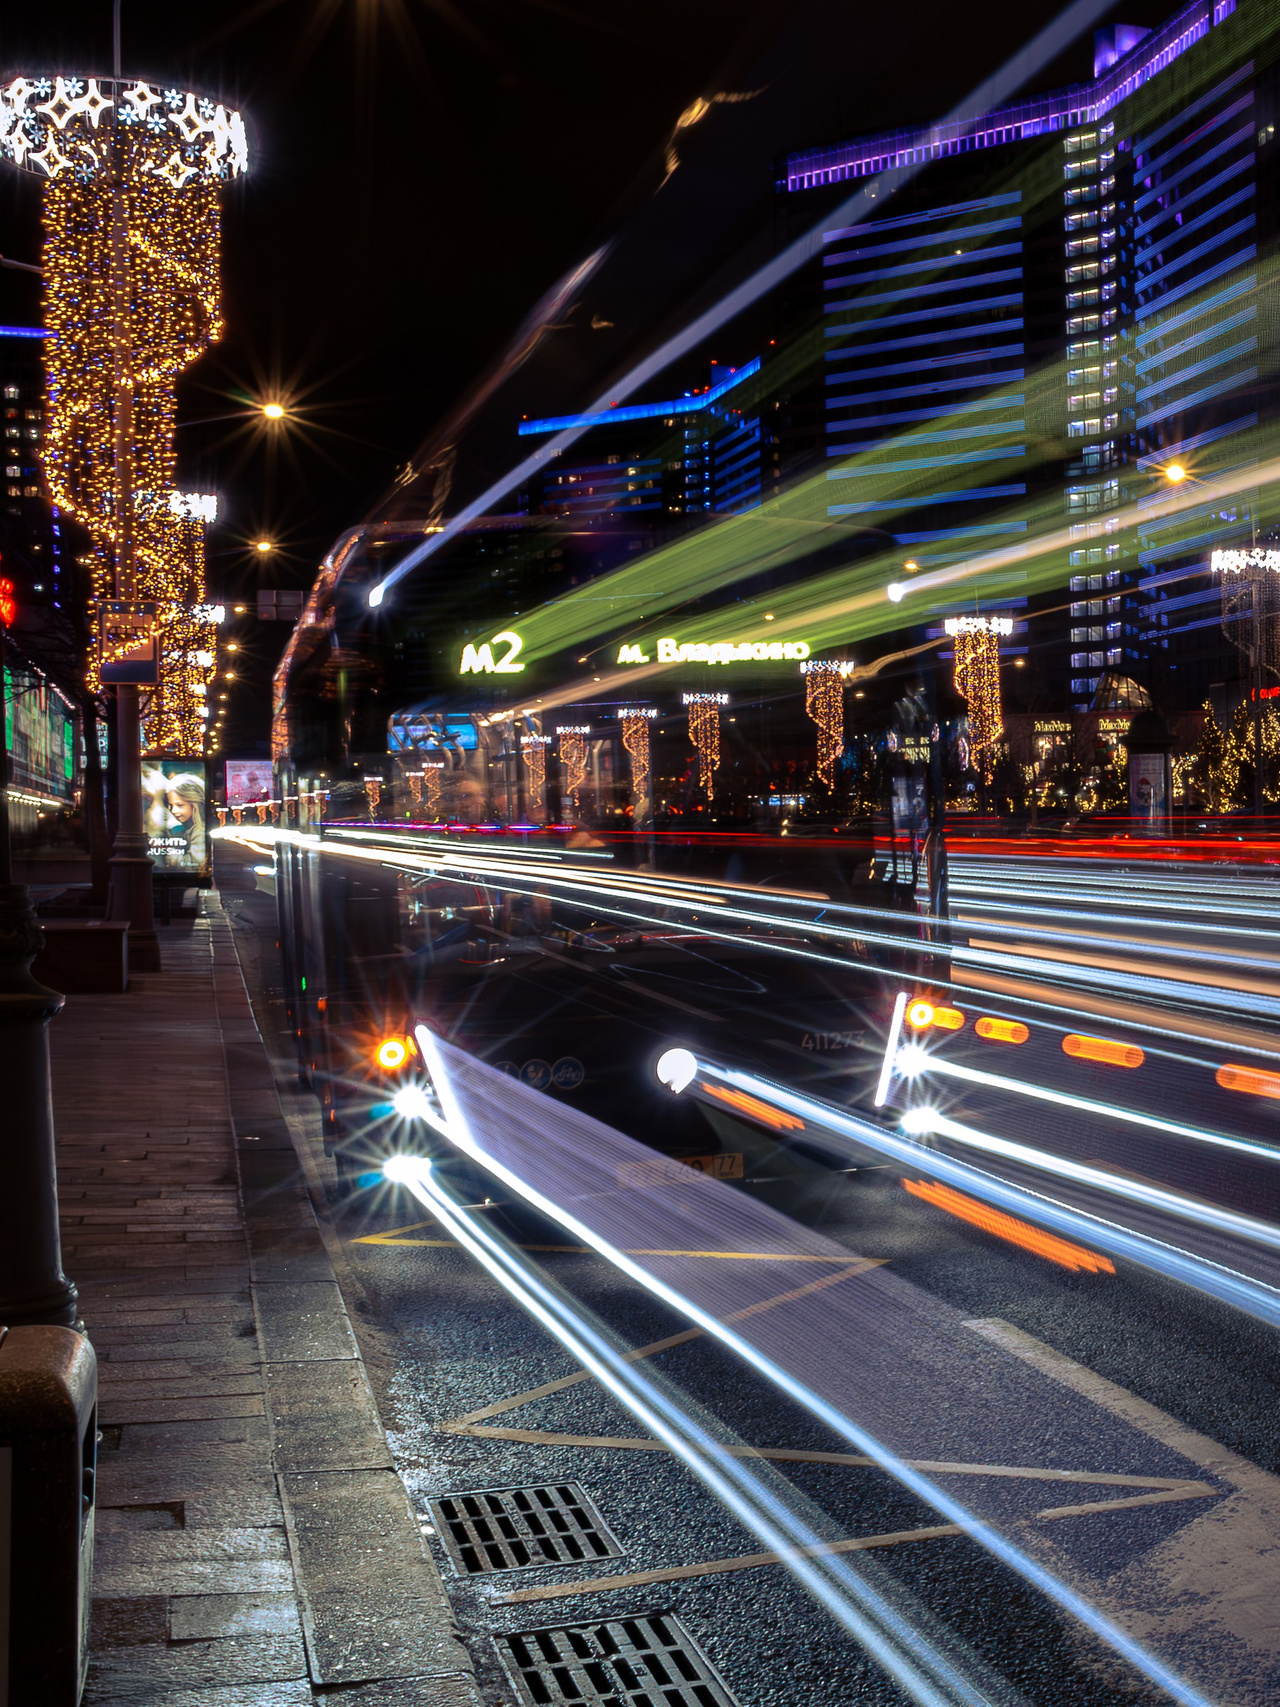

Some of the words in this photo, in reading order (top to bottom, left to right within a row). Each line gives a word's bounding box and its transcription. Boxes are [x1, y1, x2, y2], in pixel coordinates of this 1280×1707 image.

[656, 638, 811, 665] Владыкино
[801, 1029, 866, 1051] 411273
[716, 1154, 736, 1171] 77
